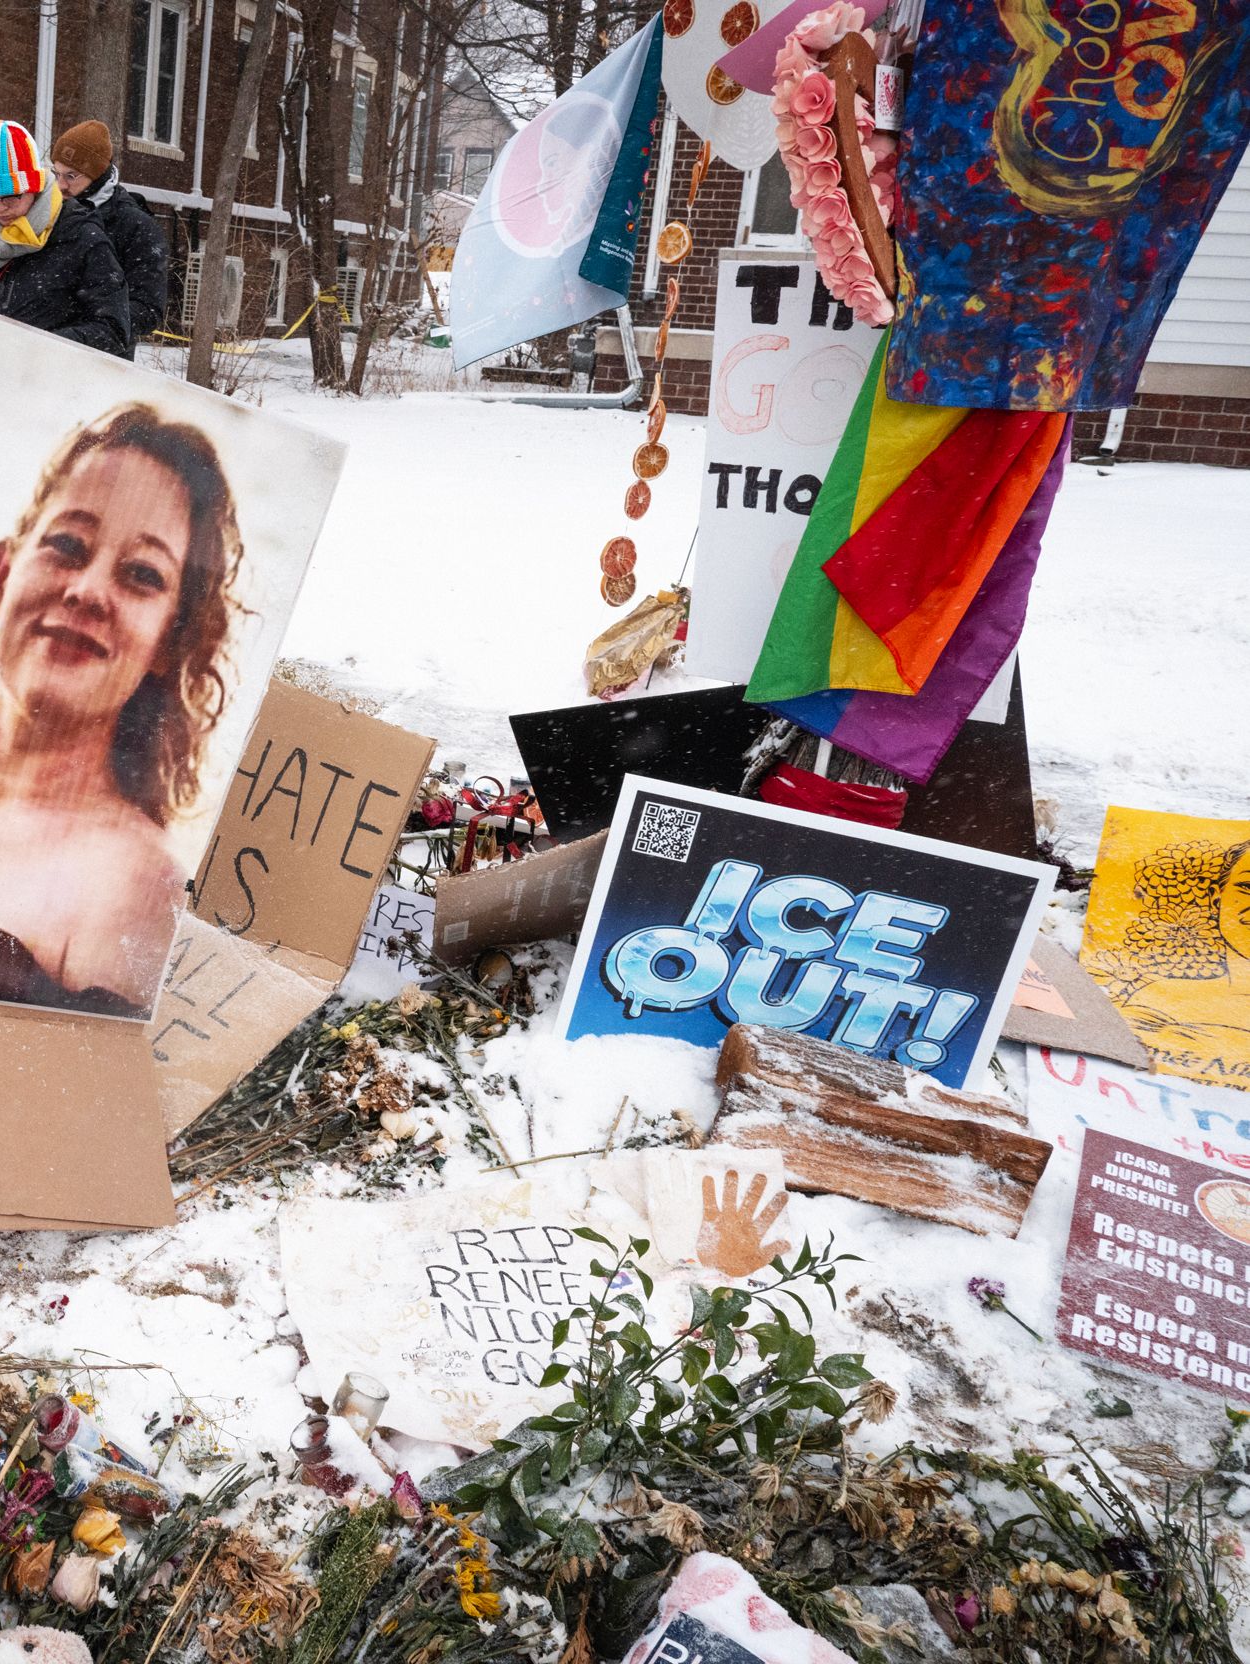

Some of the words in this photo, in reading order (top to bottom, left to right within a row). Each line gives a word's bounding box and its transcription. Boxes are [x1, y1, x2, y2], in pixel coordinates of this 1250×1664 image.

[735, 265, 888, 331] TH
[715, 334, 868, 446] GO
[708, 462, 823, 516] THO
[682, 858, 951, 980] ICE
[599, 923, 980, 1072] OUT!
[1105, 1162, 1178, 1197] DUPAGE
[1115, 1151, 1171, 1178] ¡CASA
[1090, 1174, 1190, 1218] PRESENTE!
[1093, 1212, 1235, 1277] Respeta
[426, 1265, 593, 1307] RENEE
[1094, 1293, 1217, 1355] Espera
